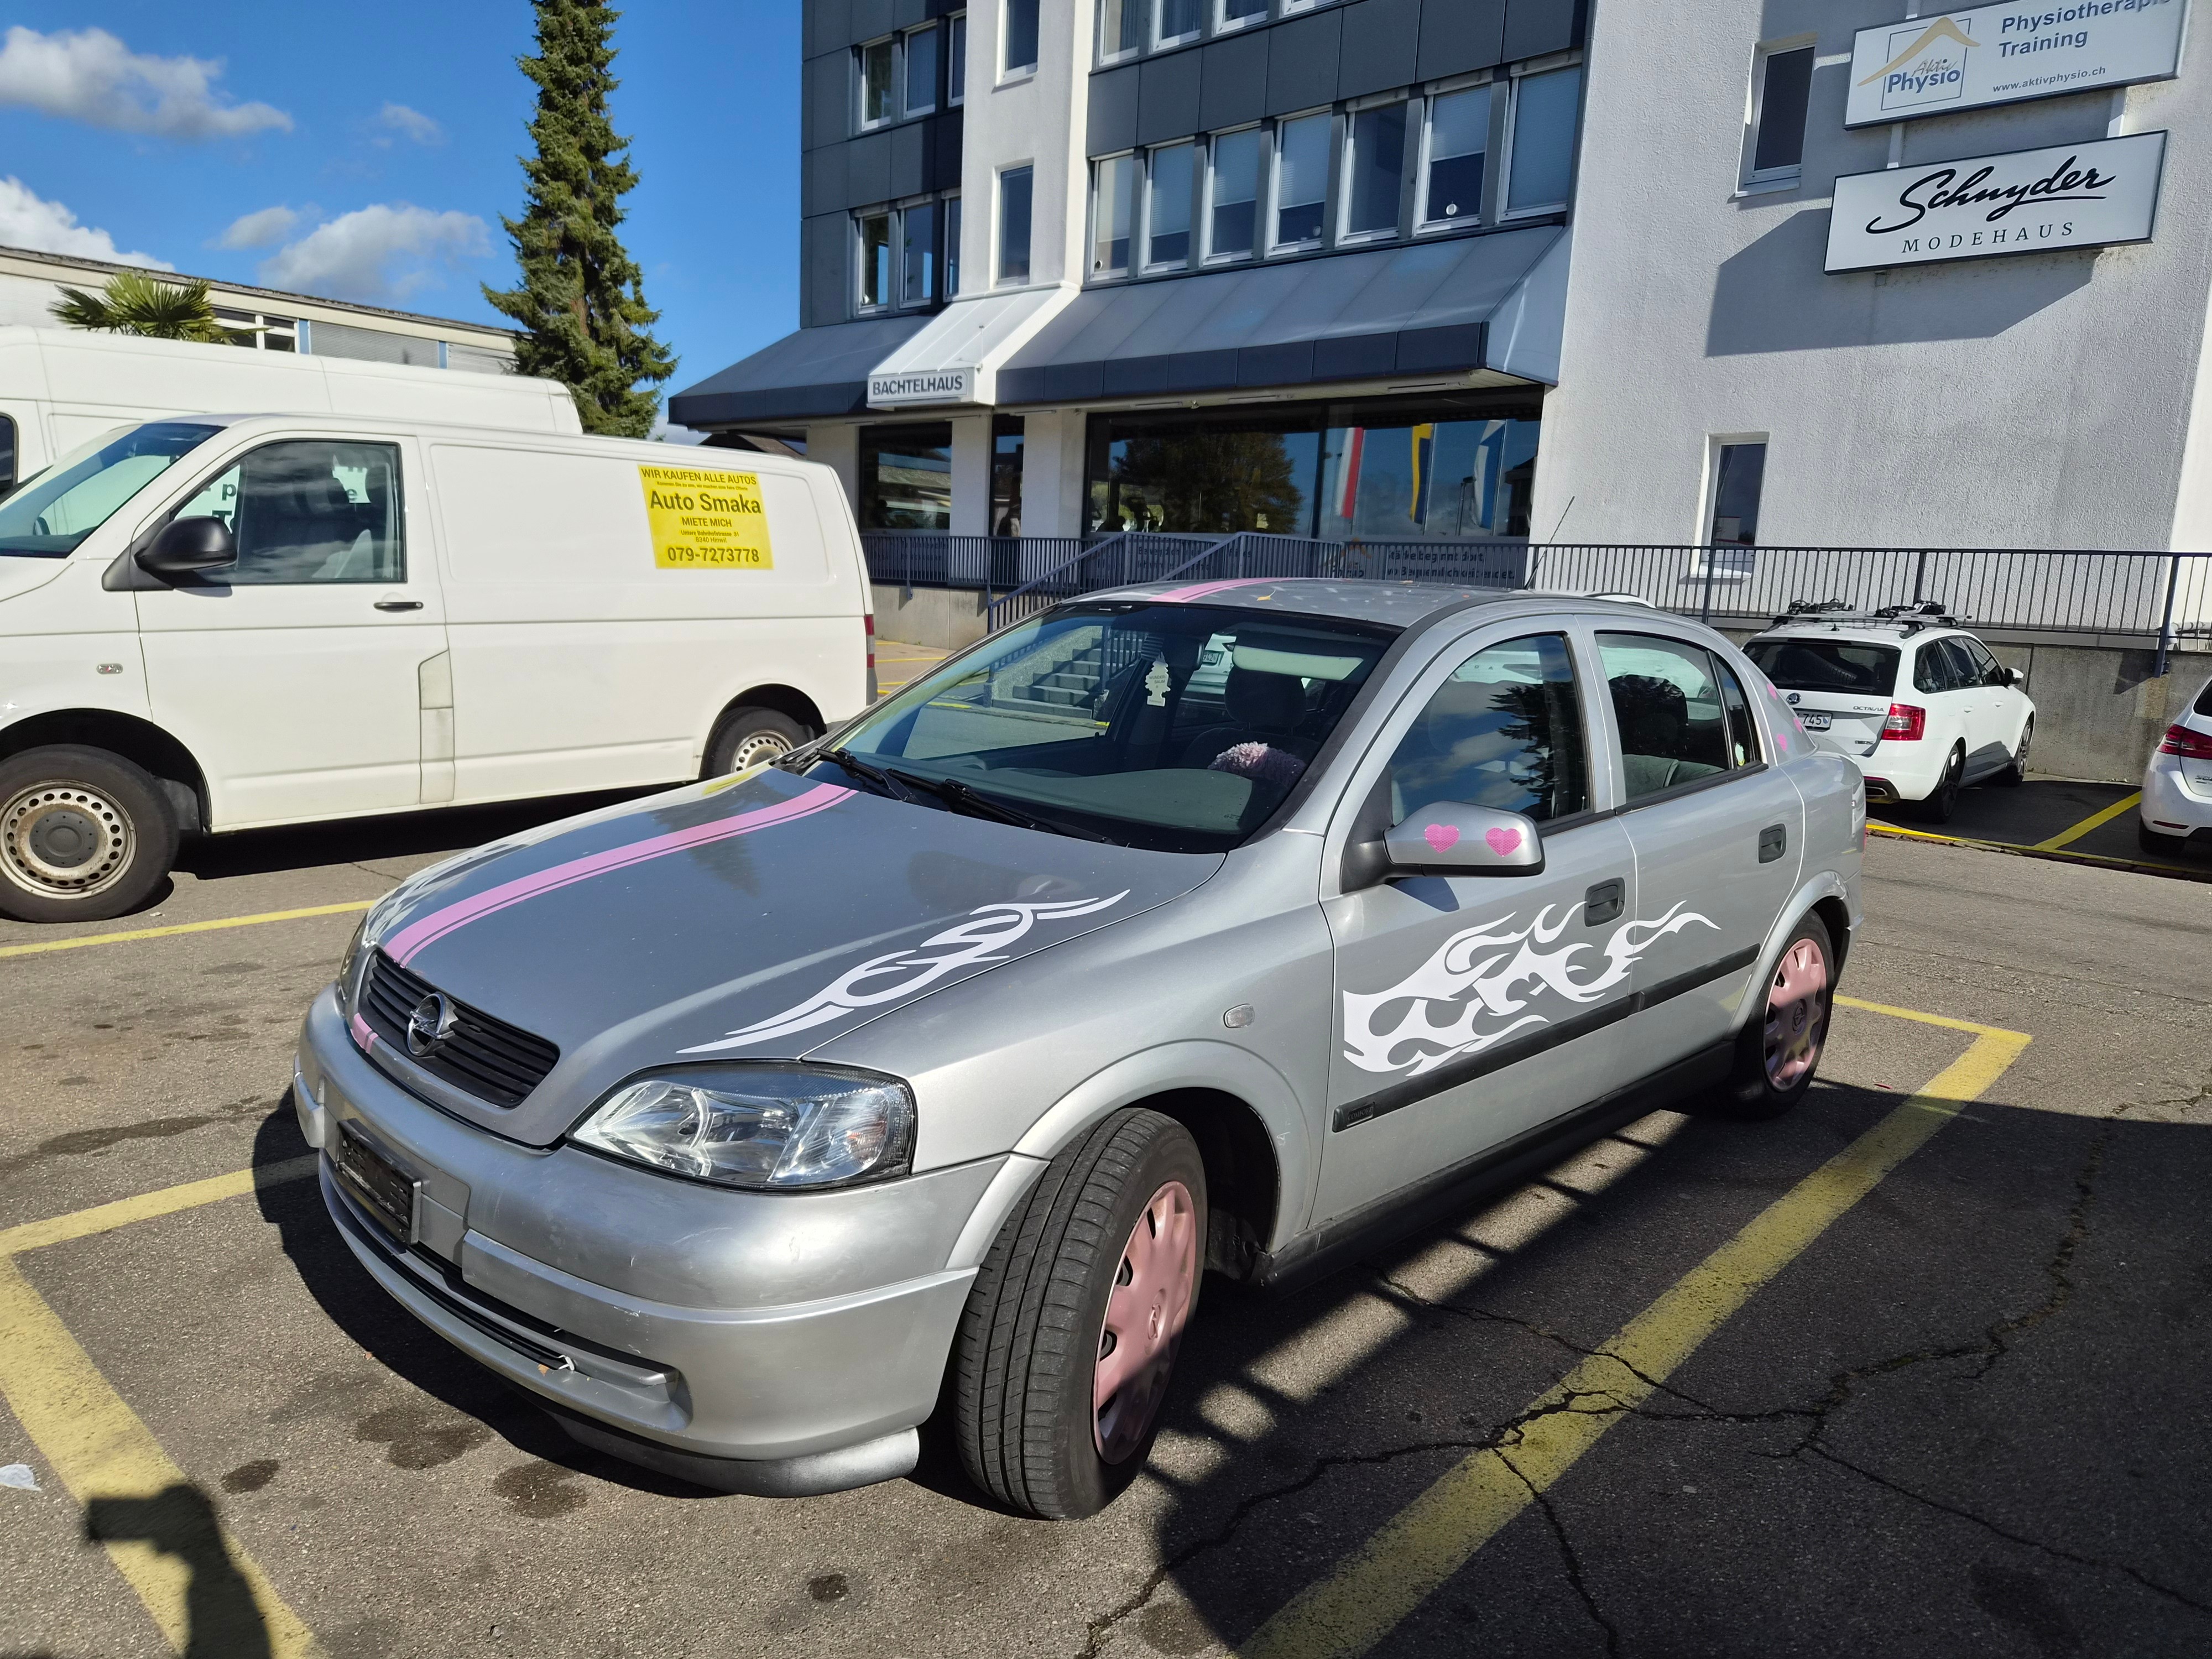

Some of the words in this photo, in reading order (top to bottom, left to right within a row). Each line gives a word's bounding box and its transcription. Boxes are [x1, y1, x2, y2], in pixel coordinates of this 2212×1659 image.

[2001, 0, 2172, 34] Physiotherap
[1999, 30, 2089, 58] Training
[1911, 58, 1959, 77] Aktiv
[1992, 66, 2106, 92] www.aktivphysio.ch
[1887, 69, 1961, 93] Physio
[1865, 155, 2117, 234] Schnyder
[1901, 221, 2074, 254] MODEHAUS
[872, 375, 963, 396] BACHTELHAUS
[641, 468, 662, 479] WIR
[663, 470, 702, 482] KAUFEN
[704, 473, 726, 483] ALLE
[728, 474, 757, 485] AUTOS
[650, 490, 695, 511] Auto
[699, 493, 762, 514] Smaka
[681, 517, 708, 527] MIETE
[710, 518, 733, 528] MICH
[667, 546, 760, 564] 079-7273778
[1803, 713, 1822, 726] 745
